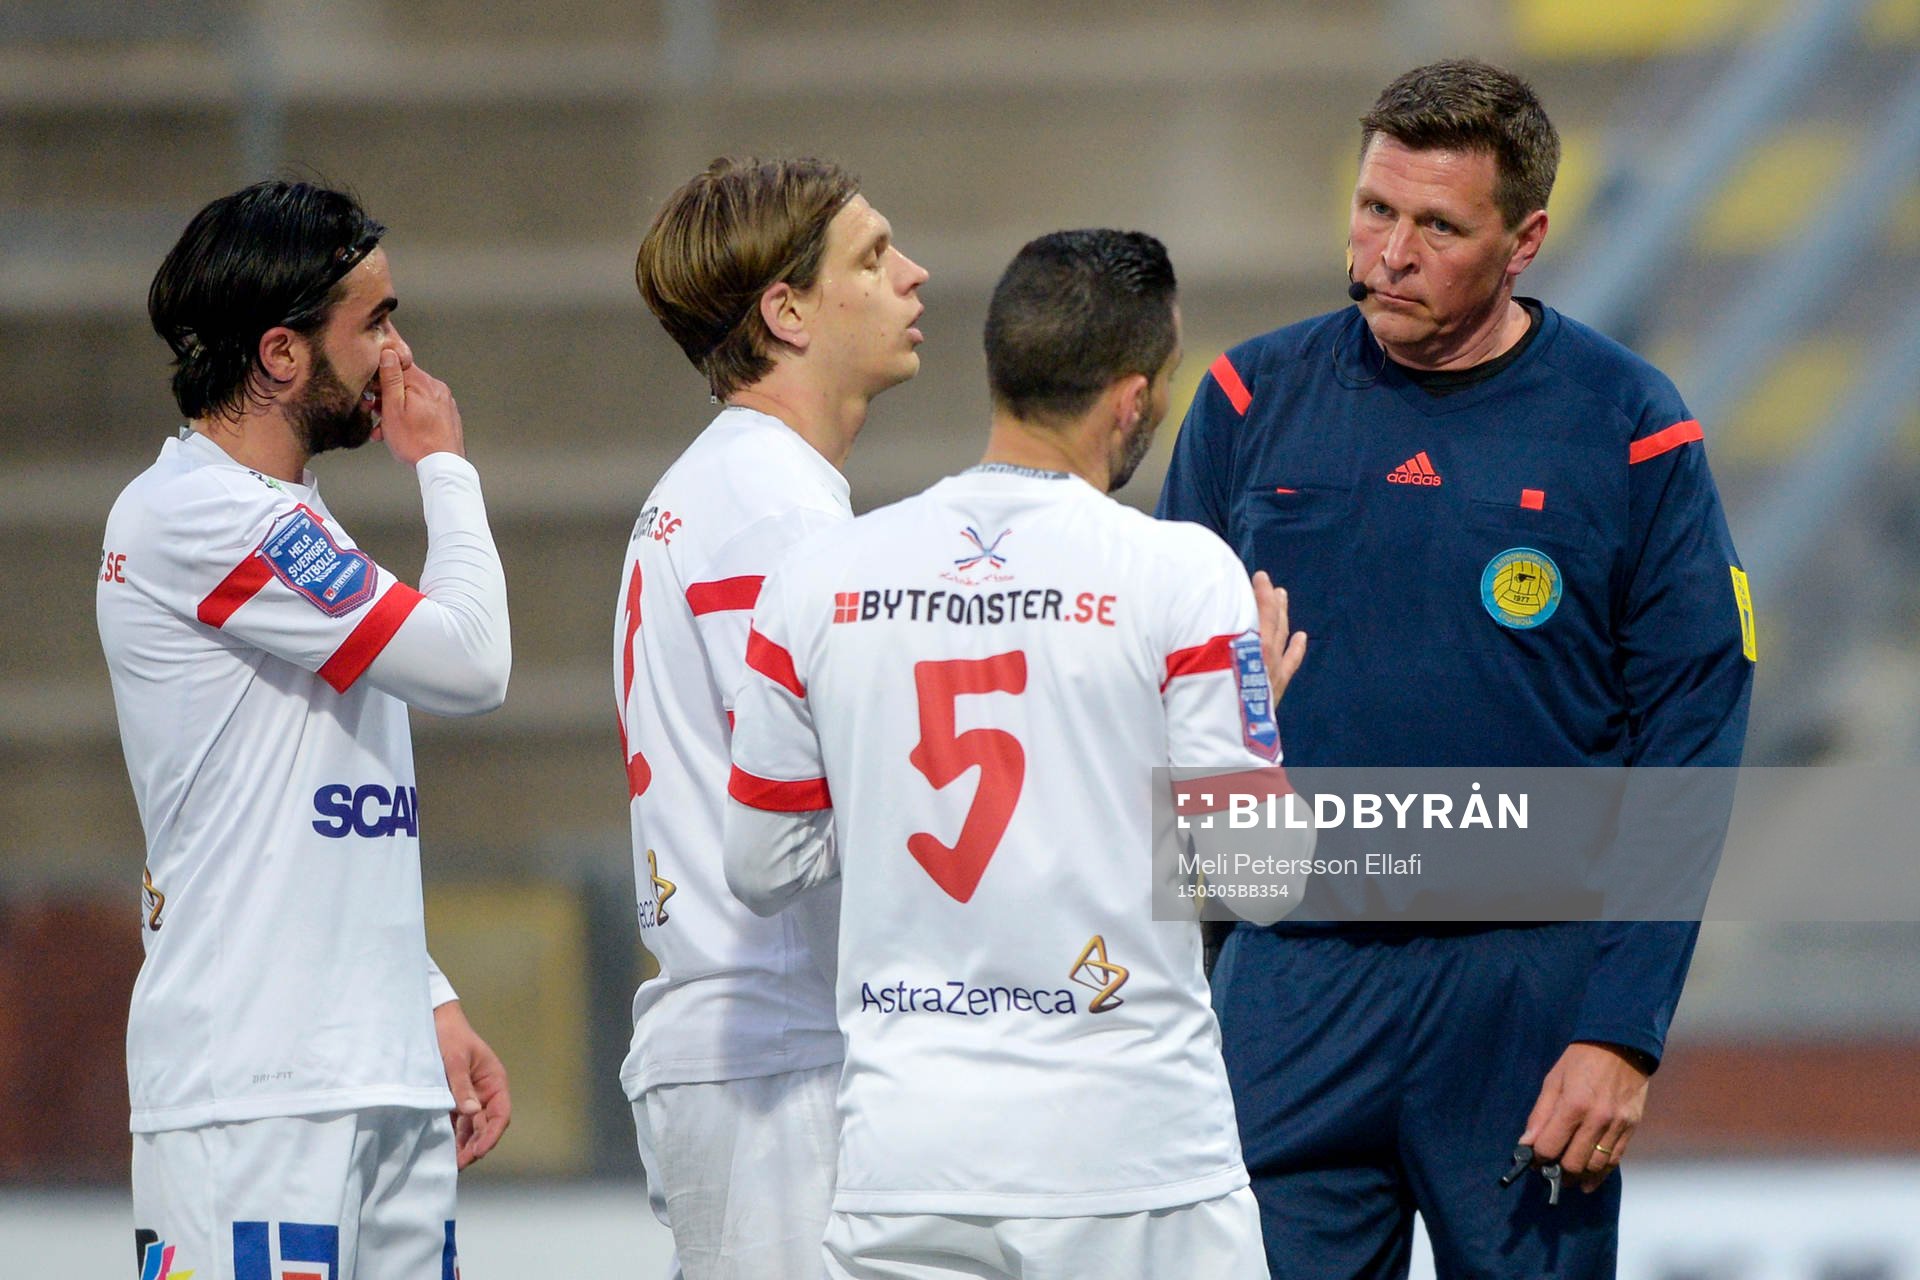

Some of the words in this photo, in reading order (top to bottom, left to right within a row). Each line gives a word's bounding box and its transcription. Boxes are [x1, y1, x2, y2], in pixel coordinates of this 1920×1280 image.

[1387, 472, 1442, 487] adidas
[288, 534, 314, 559] HELA
[288, 537, 328, 578] SVERIGES
[294, 548, 337, 587] FOTBOLLS
[861, 588, 1117, 627] BYTFONSTER.SE
[907, 649, 1028, 904] 5
[861, 980, 1077, 1016] AstraZeneca
